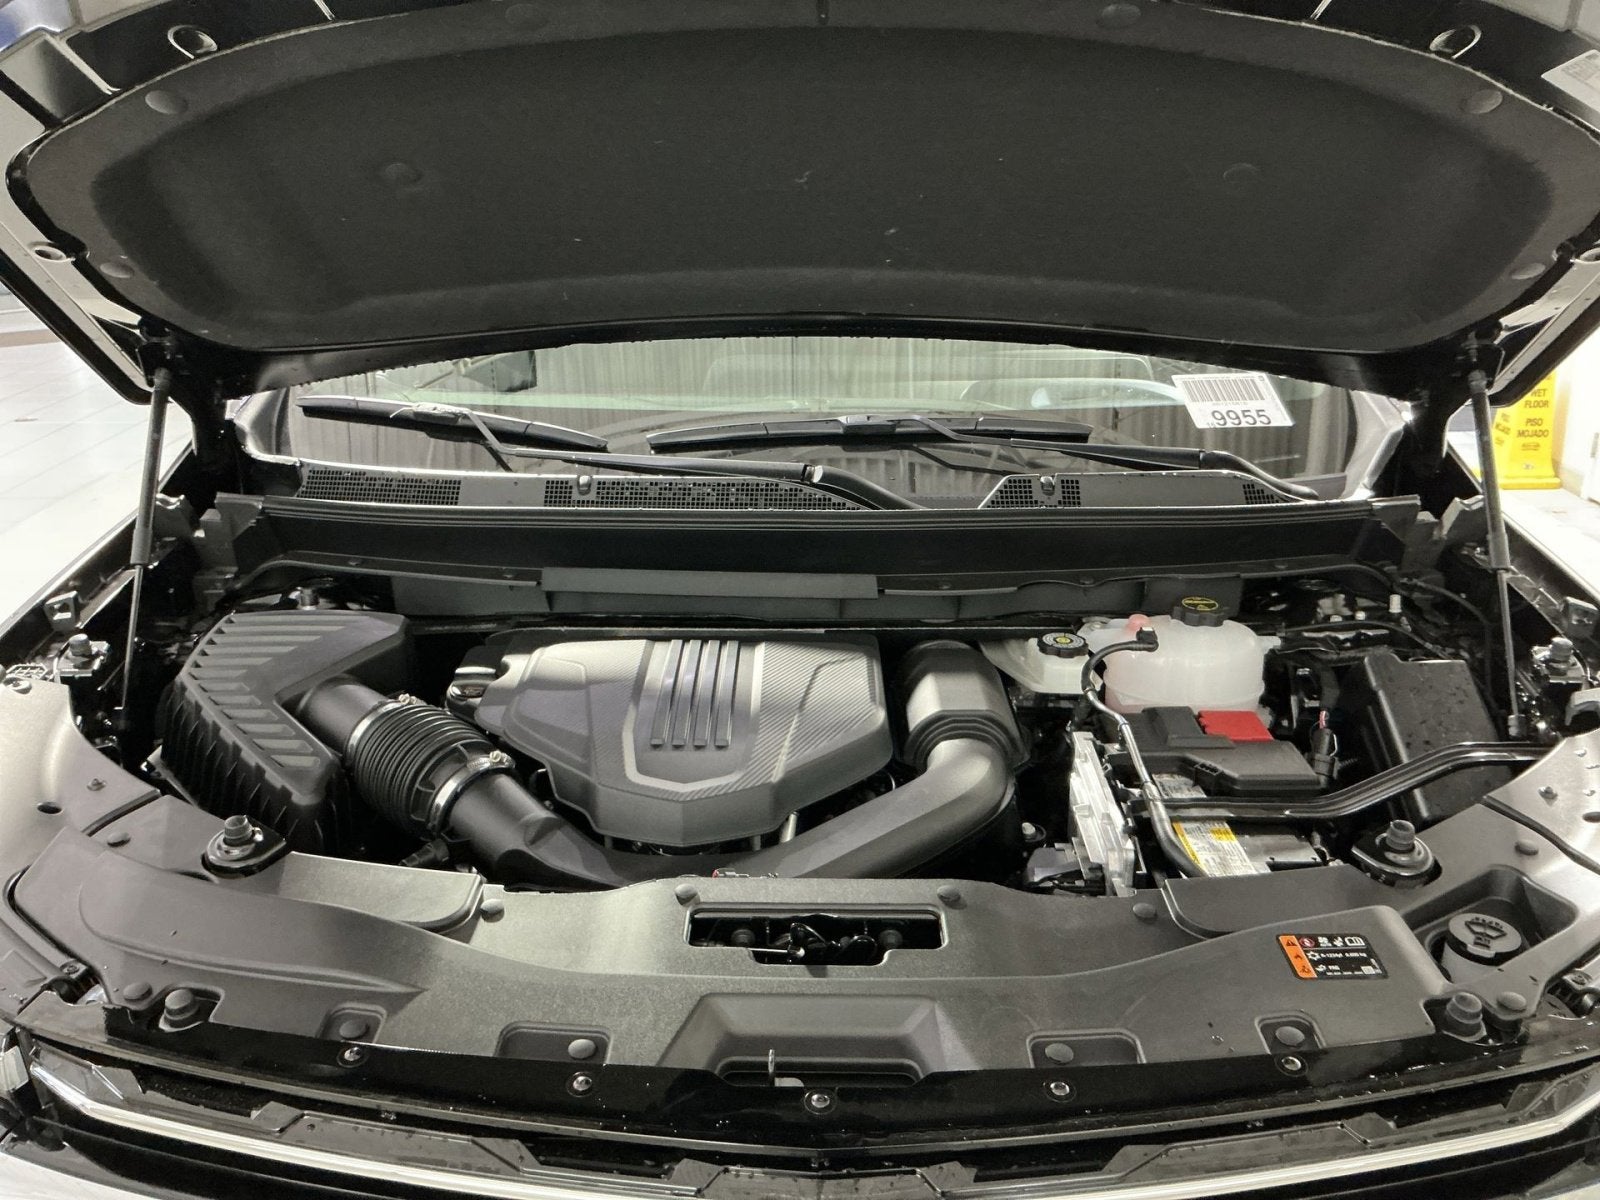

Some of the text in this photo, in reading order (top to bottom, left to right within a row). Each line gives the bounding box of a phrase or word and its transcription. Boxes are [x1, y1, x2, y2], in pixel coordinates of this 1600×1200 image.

[1524, 399, 1549, 408] FLOOR
[1211, 409, 1271, 427] 9955
[1525, 418, 1543, 427] PISO
[1516, 429, 1549, 438] MOJADO
